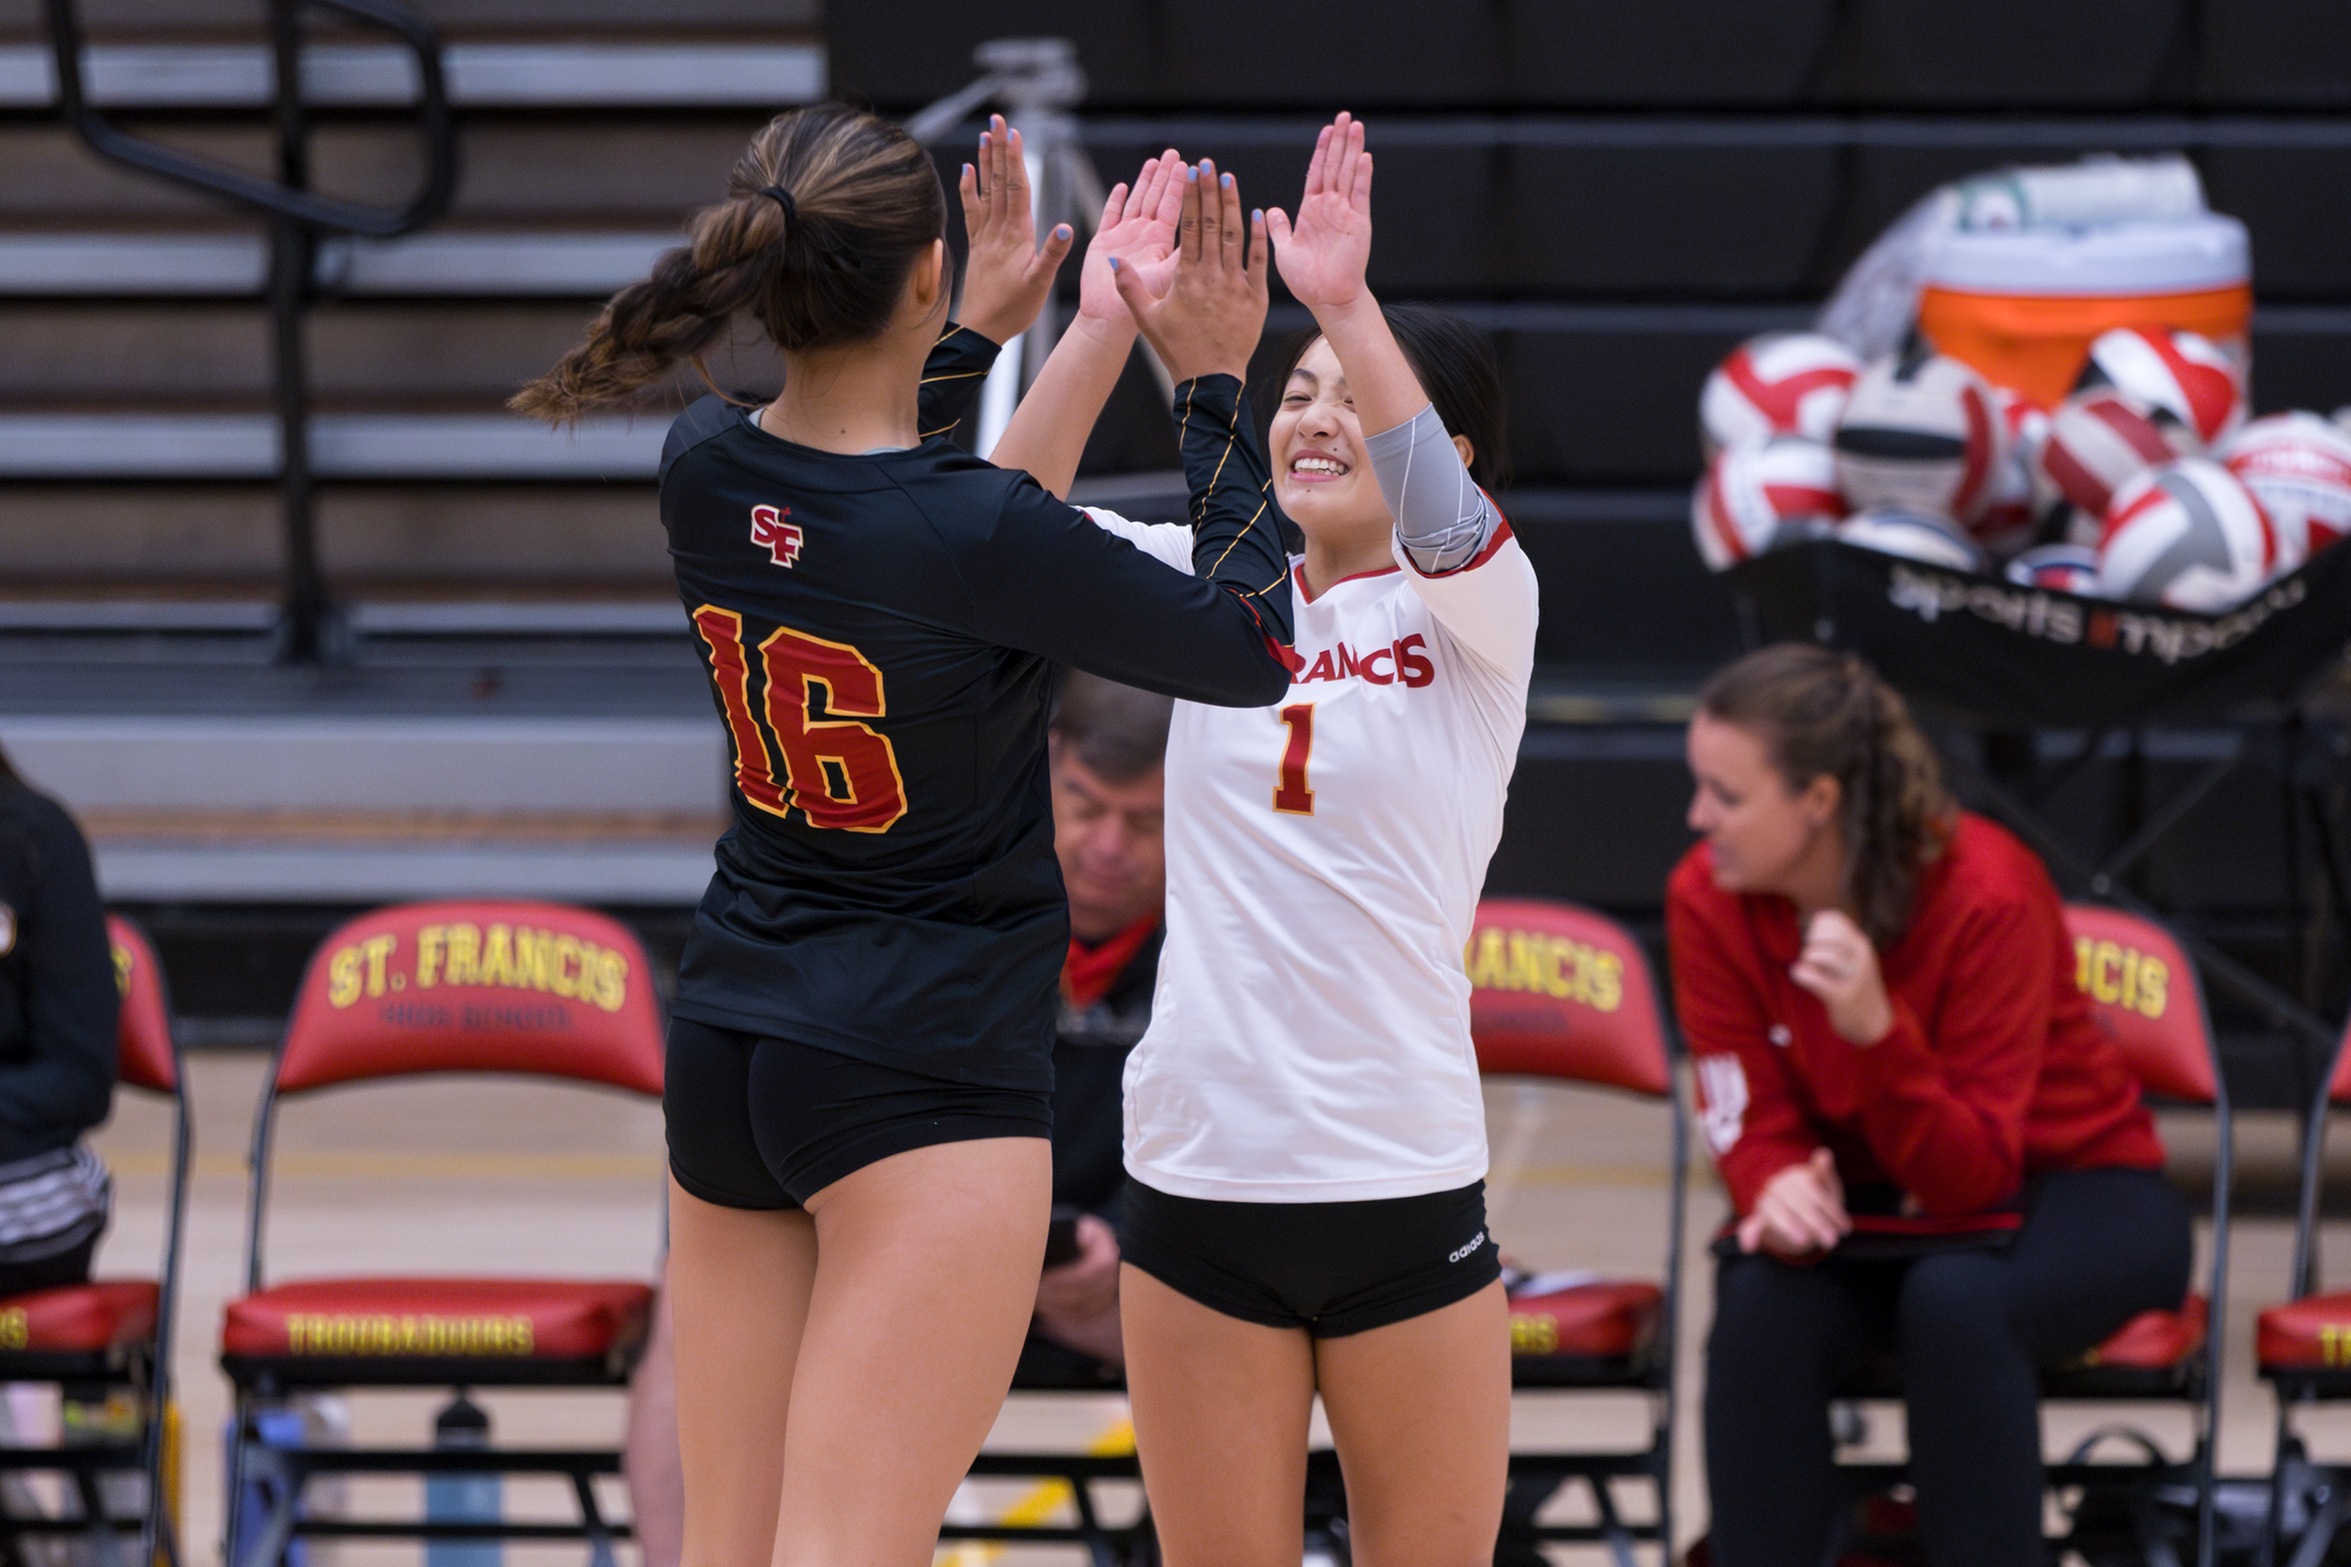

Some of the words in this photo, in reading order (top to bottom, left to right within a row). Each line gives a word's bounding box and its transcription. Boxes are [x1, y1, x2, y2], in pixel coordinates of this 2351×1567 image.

[751, 504, 803, 569] SF
[693, 603, 908, 834] 16
[1272, 702, 1317, 816] 1
[329, 933, 407, 1009] ST.
[416, 922, 629, 1013] FRANCIS
[1464, 926, 1624, 1013] ANCIS
[1449, 1231, 1485, 1263] adidas
